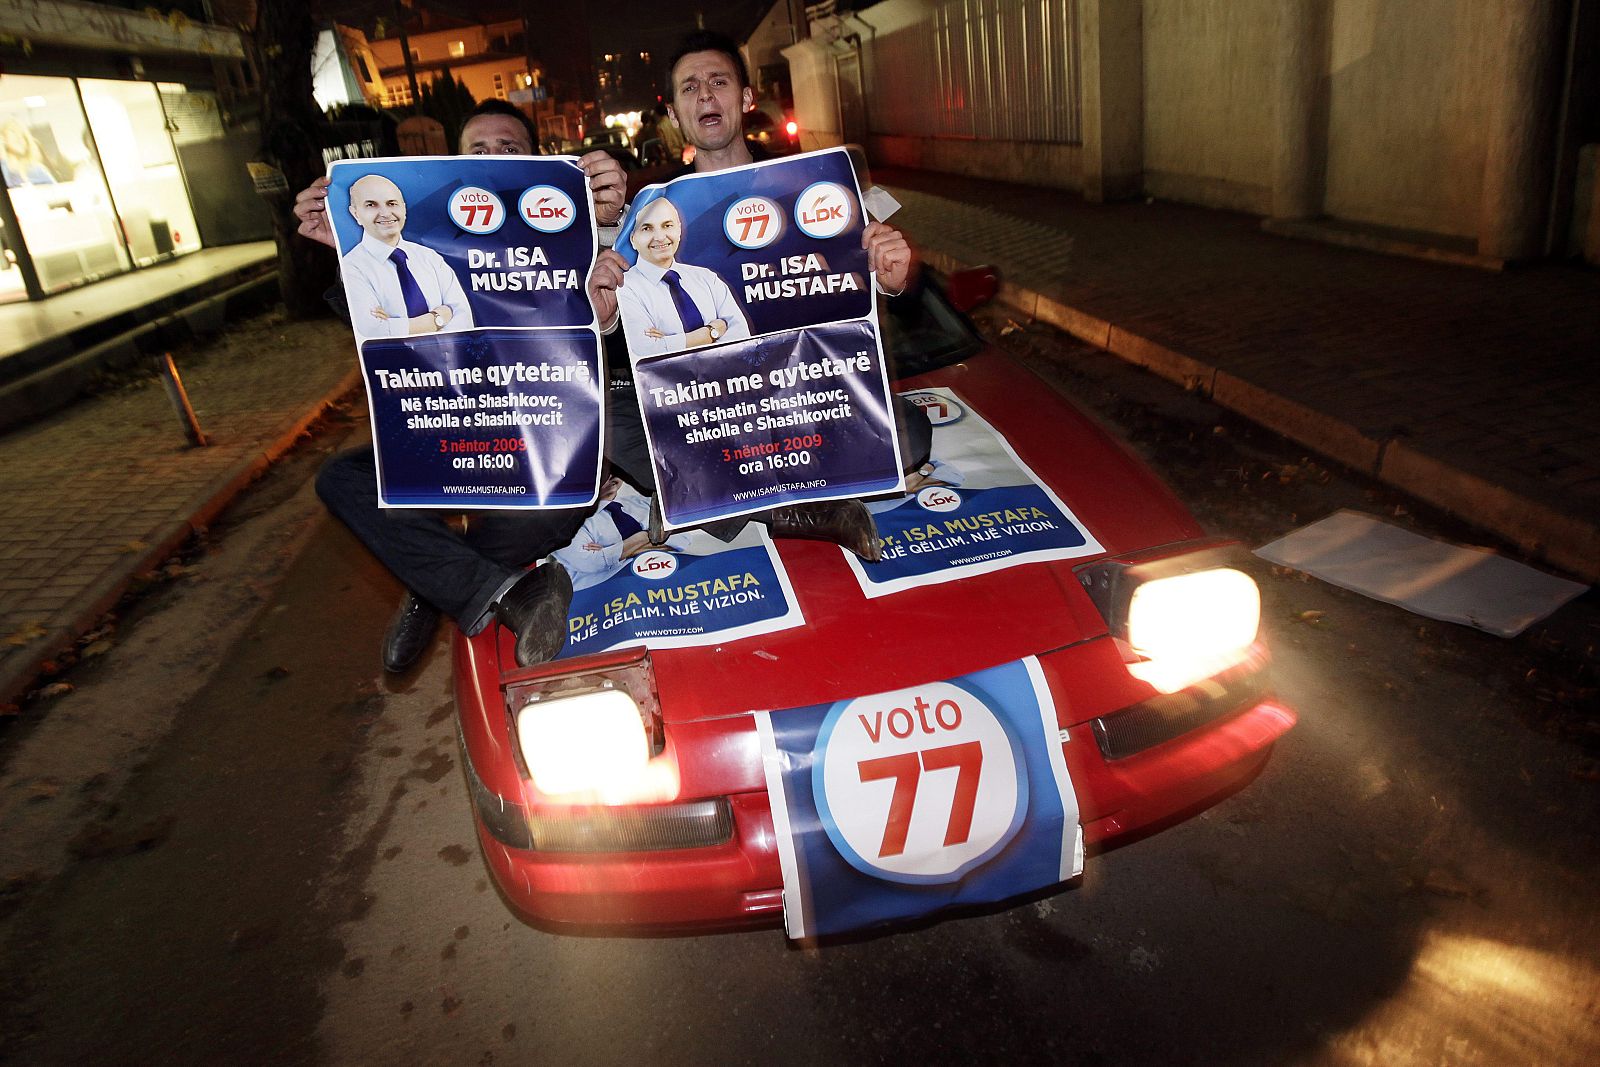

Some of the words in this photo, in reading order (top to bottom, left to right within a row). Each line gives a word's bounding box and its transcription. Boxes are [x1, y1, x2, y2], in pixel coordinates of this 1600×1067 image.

[461, 192, 489, 203] voto
[737, 202, 765, 215] voto
[460, 204, 494, 226] 77
[526, 207, 569, 219] LDK
[802, 205, 844, 225] LDK
[735, 214, 770, 241] 77
[468, 249, 501, 269] Dr.
[508, 246, 548, 267] ISA
[741, 262, 775, 281] Dr.
[781, 253, 822, 274] ISA
[471, 269, 579, 291] MUSTAFA
[745, 273, 858, 303] MUSTAFA
[375, 367, 443, 389] Takim
[450, 367, 483, 386] me
[487, 360, 590, 386] qytetarë
[649, 379, 721, 408] Takim
[727, 373, 763, 395] me
[769, 351, 872, 387] qytetarë
[401, 397, 422, 413] Në
[425, 394, 476, 411] fshatin
[479, 393, 563, 410] Shashkovc,
[677, 411, 699, 428] Në
[702, 400, 757, 423] fshatin
[760, 387, 849, 413] Shashkovc,
[912, 396, 938, 405] oto
[920, 402, 948, 418] 7
[407, 413, 459, 429] shkolla
[463, 416, 471, 427] e
[474, 411, 563, 427] Shashkovcit
[686, 423, 740, 444] shkolla
[745, 421, 753, 433] e
[757, 405, 851, 431] Shashkovcit
[440, 439, 448, 453] 3
[451, 439, 491, 452] nëntor
[493, 438, 527, 451] 2009
[722, 449, 731, 462] 3
[734, 441, 781, 460] nëntor
[784, 434, 823, 453] 2009
[453, 456, 475, 468] ora
[478, 454, 514, 469] 16:00
[739, 460, 764, 475] ora
[767, 450, 811, 470] 16:00
[443, 485, 526, 494] WWW.ISAMUSTAFA.INFO
[733, 479, 827, 501] WWW.ISAMUSTAFA.INFO
[923, 495, 958, 508] LDK
[902, 524, 944, 542] ISA
[943, 507, 1048, 534] MUSTAFA
[909, 535, 970, 554] QËLLIM.
[971, 529, 1002, 545] NJË
[1001, 520, 1059, 538] VIZION.
[637, 560, 673, 573] LDK
[950, 549, 1012, 566] WWW.VOTO77.COM
[569, 613, 598, 633] Dr.
[604, 593, 642, 616] ISA
[648, 572, 760, 604] MUSTAFA
[570, 623, 598, 645] NJË
[603, 605, 665, 630] QËLLIM.
[669, 601, 700, 617] NJË
[703, 589, 765, 612] VIZION.
[635, 626, 704, 638] WWW.VOTO77.COM
[858, 696, 962, 744] voto
[857, 740, 983, 858] 77
